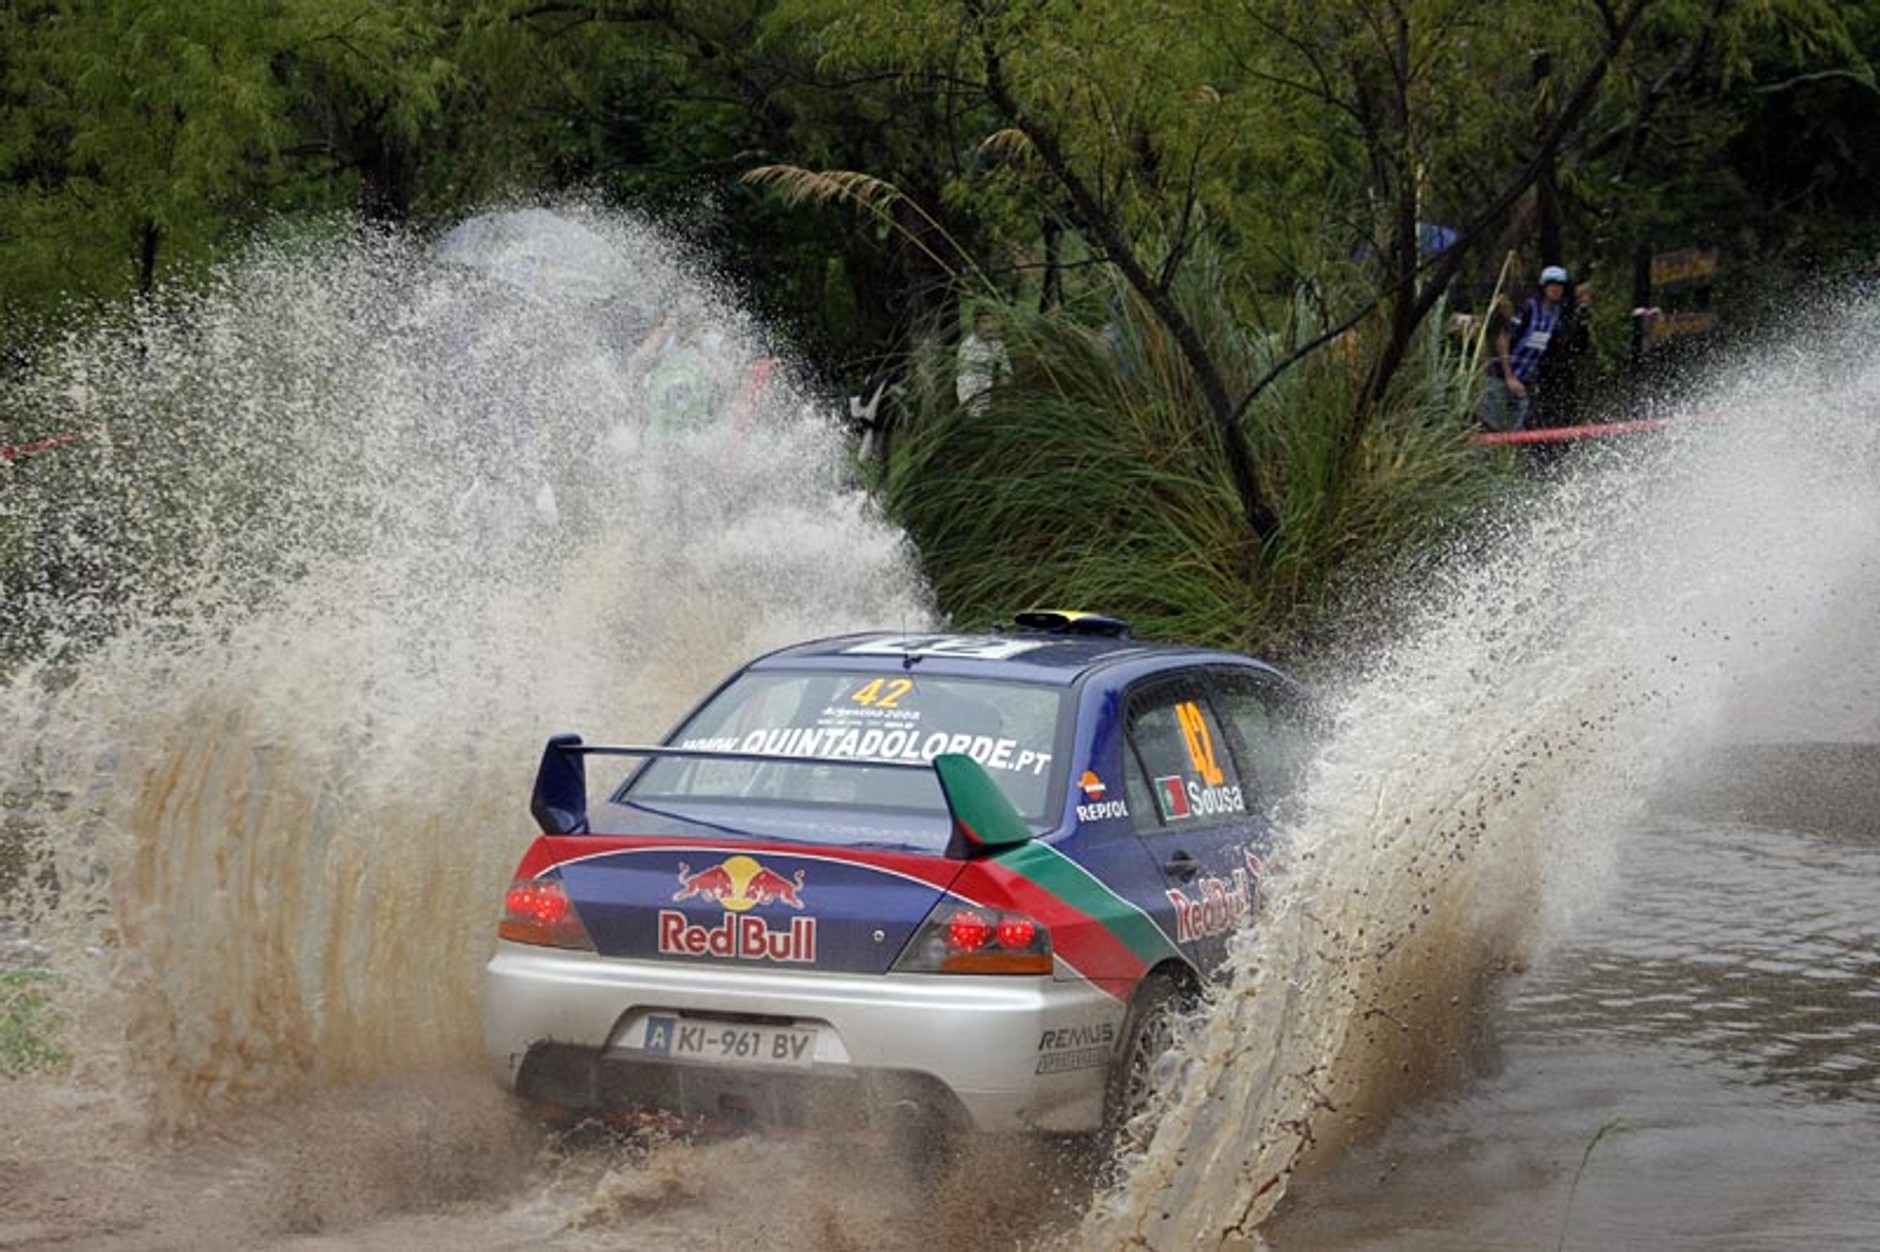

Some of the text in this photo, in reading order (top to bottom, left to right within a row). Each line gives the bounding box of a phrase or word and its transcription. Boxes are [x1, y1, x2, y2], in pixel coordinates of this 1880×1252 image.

[850, 676, 914, 708] 42
[1076, 800, 1128, 822] REPSOL
[1187, 780, 1244, 816] Sousa
[658, 909, 817, 963] Red Bull
[651, 1026, 809, 1059] A KI-961 BV
[1038, 1022, 1114, 1051] REMUS
